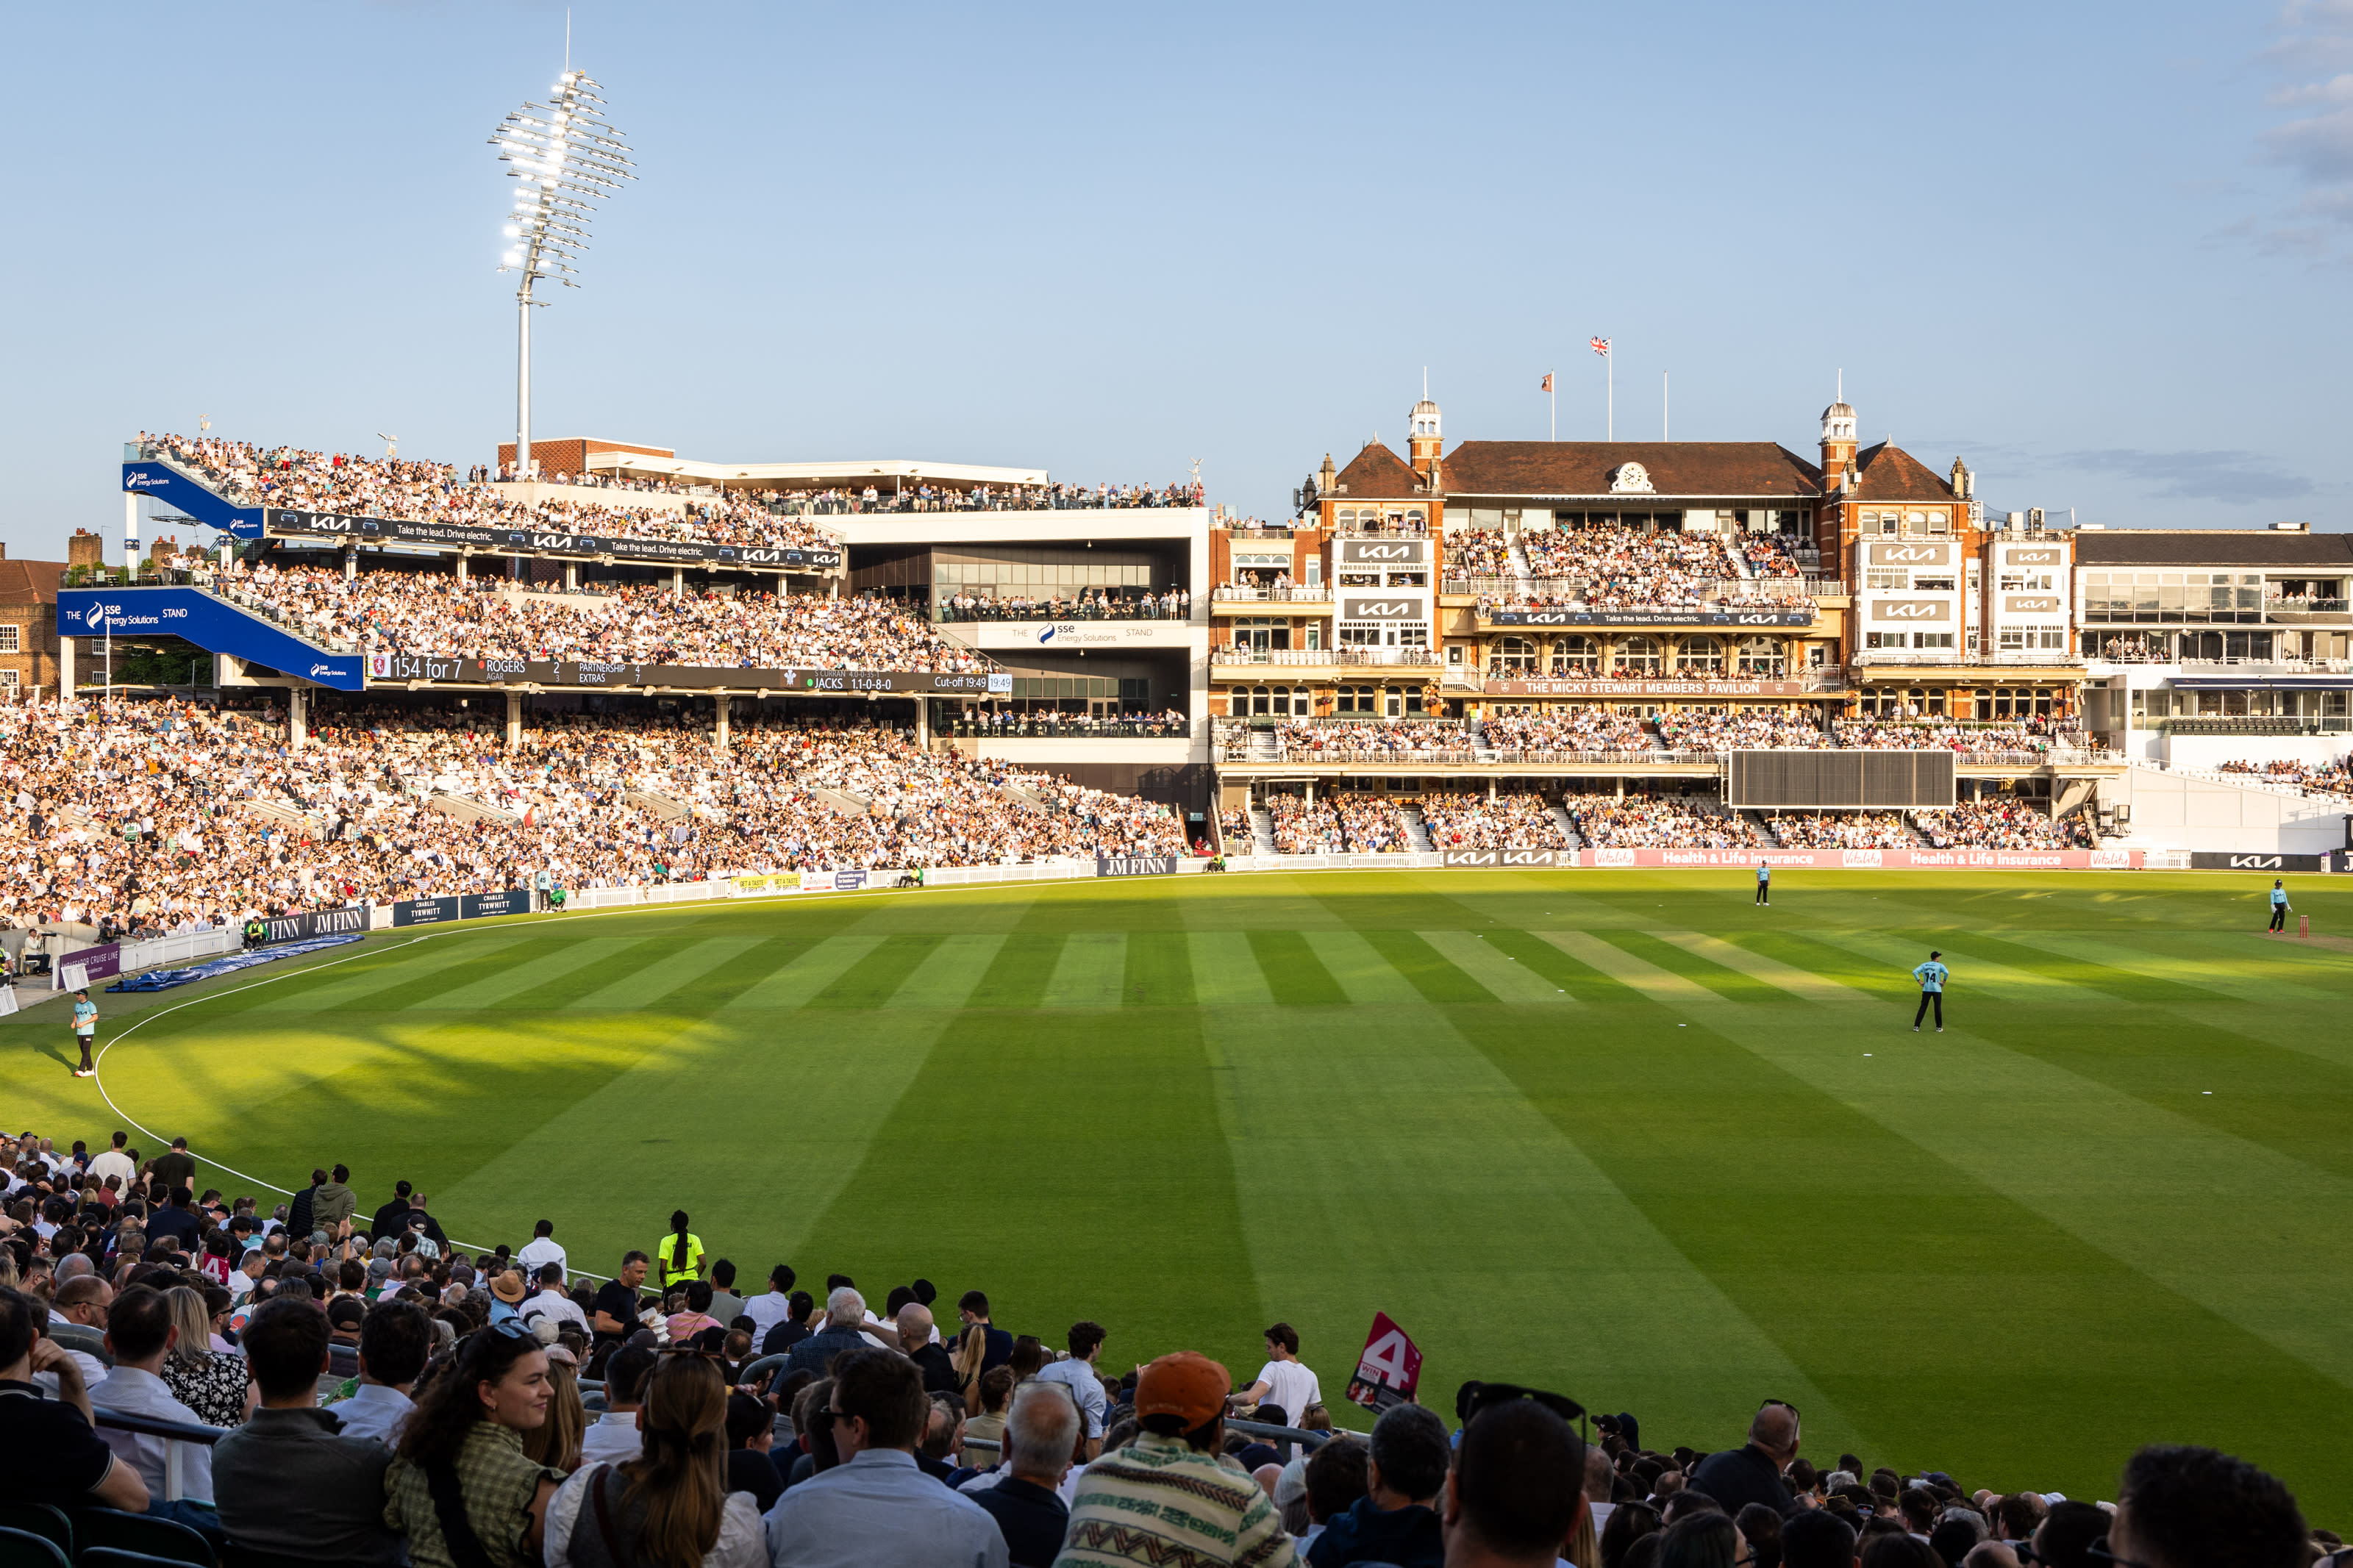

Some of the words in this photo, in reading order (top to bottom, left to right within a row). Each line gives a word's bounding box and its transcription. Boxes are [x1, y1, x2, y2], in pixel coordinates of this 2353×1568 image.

[398, 525, 414, 535] Take
[415, 526, 428, 536] the
[429, 528, 446, 537] lead.
[447, 529, 465, 539] Drive
[466, 531, 493, 541] electric.
[612, 542, 627, 551] Take
[629, 543, 640, 551] the
[641, 544, 657, 553] lead.
[659, 545, 676, 554] Drive
[678, 546, 703, 556] electric.
[66, 611, 81, 620] THE
[104, 604, 121, 615] sse
[163, 609, 188, 618] STAND
[105, 616, 127, 626] Energy
[128, 615, 158, 624] Solutions
[1057, 634, 1082, 642] Energy
[394, 658, 421, 678] 154
[426, 658, 449, 679] for
[453, 659, 463, 679] 7
[487, 660, 525, 673] ROGERS
[554, 662, 560, 674] 2
[579, 662, 625, 673] PARTNERSHIP
[635, 665, 640, 673] 4
[487, 673, 504, 681] AGAR
[579, 673, 605, 682] EXTRAS
[635, 674, 640, 682] 7
[820, 670, 846, 678] CURRAN
[815, 678, 843, 690] JACKS
[852, 678, 891, 690] 1.1-0-8-0
[935, 676, 963, 688] Cut-off
[965, 677, 985, 688] 19:49
[990, 677, 1010, 688] 19:49
[1527, 683, 1549, 692] THE
[1552, 683, 1588, 692] MICKY
[1591, 683, 1642, 693] STEWART
[1646, 683, 1705, 693] MEMBERS'
[1709, 683, 1760, 693] PAVILION
[1597, 851, 1632, 866] Vitality
[1663, 851, 1706, 864] Health
[1709, 852, 1718, 864] &
[1722, 851, 1747, 864] Life
[1751, 852, 1813, 864] insurance
[1845, 853, 1882, 867] Vitality
[1911, 853, 1954, 864] Health
[1957, 853, 1965, 864] &
[1970, 853, 1993, 864] Life
[1998, 853, 2061, 865] insurance
[2093, 853, 2129, 867] Vitality
[1107, 859, 1128, 875] JM
[1131, 858, 1168, 874] FINN
[479, 901, 510, 910] TYRWHITT
[411, 908, 440, 917] TYRWHITT
[271, 918, 299, 939] FINN
[315, 914, 331, 934] JM
[334, 911, 362, 934] FINN
[90, 953, 106, 964] CRUISE
[108, 951, 118, 961] LINE
[205, 1257, 222, 1284] 4
[1362, 1329, 1410, 1390] 4
[1362, 1364, 1379, 1376] WIN
